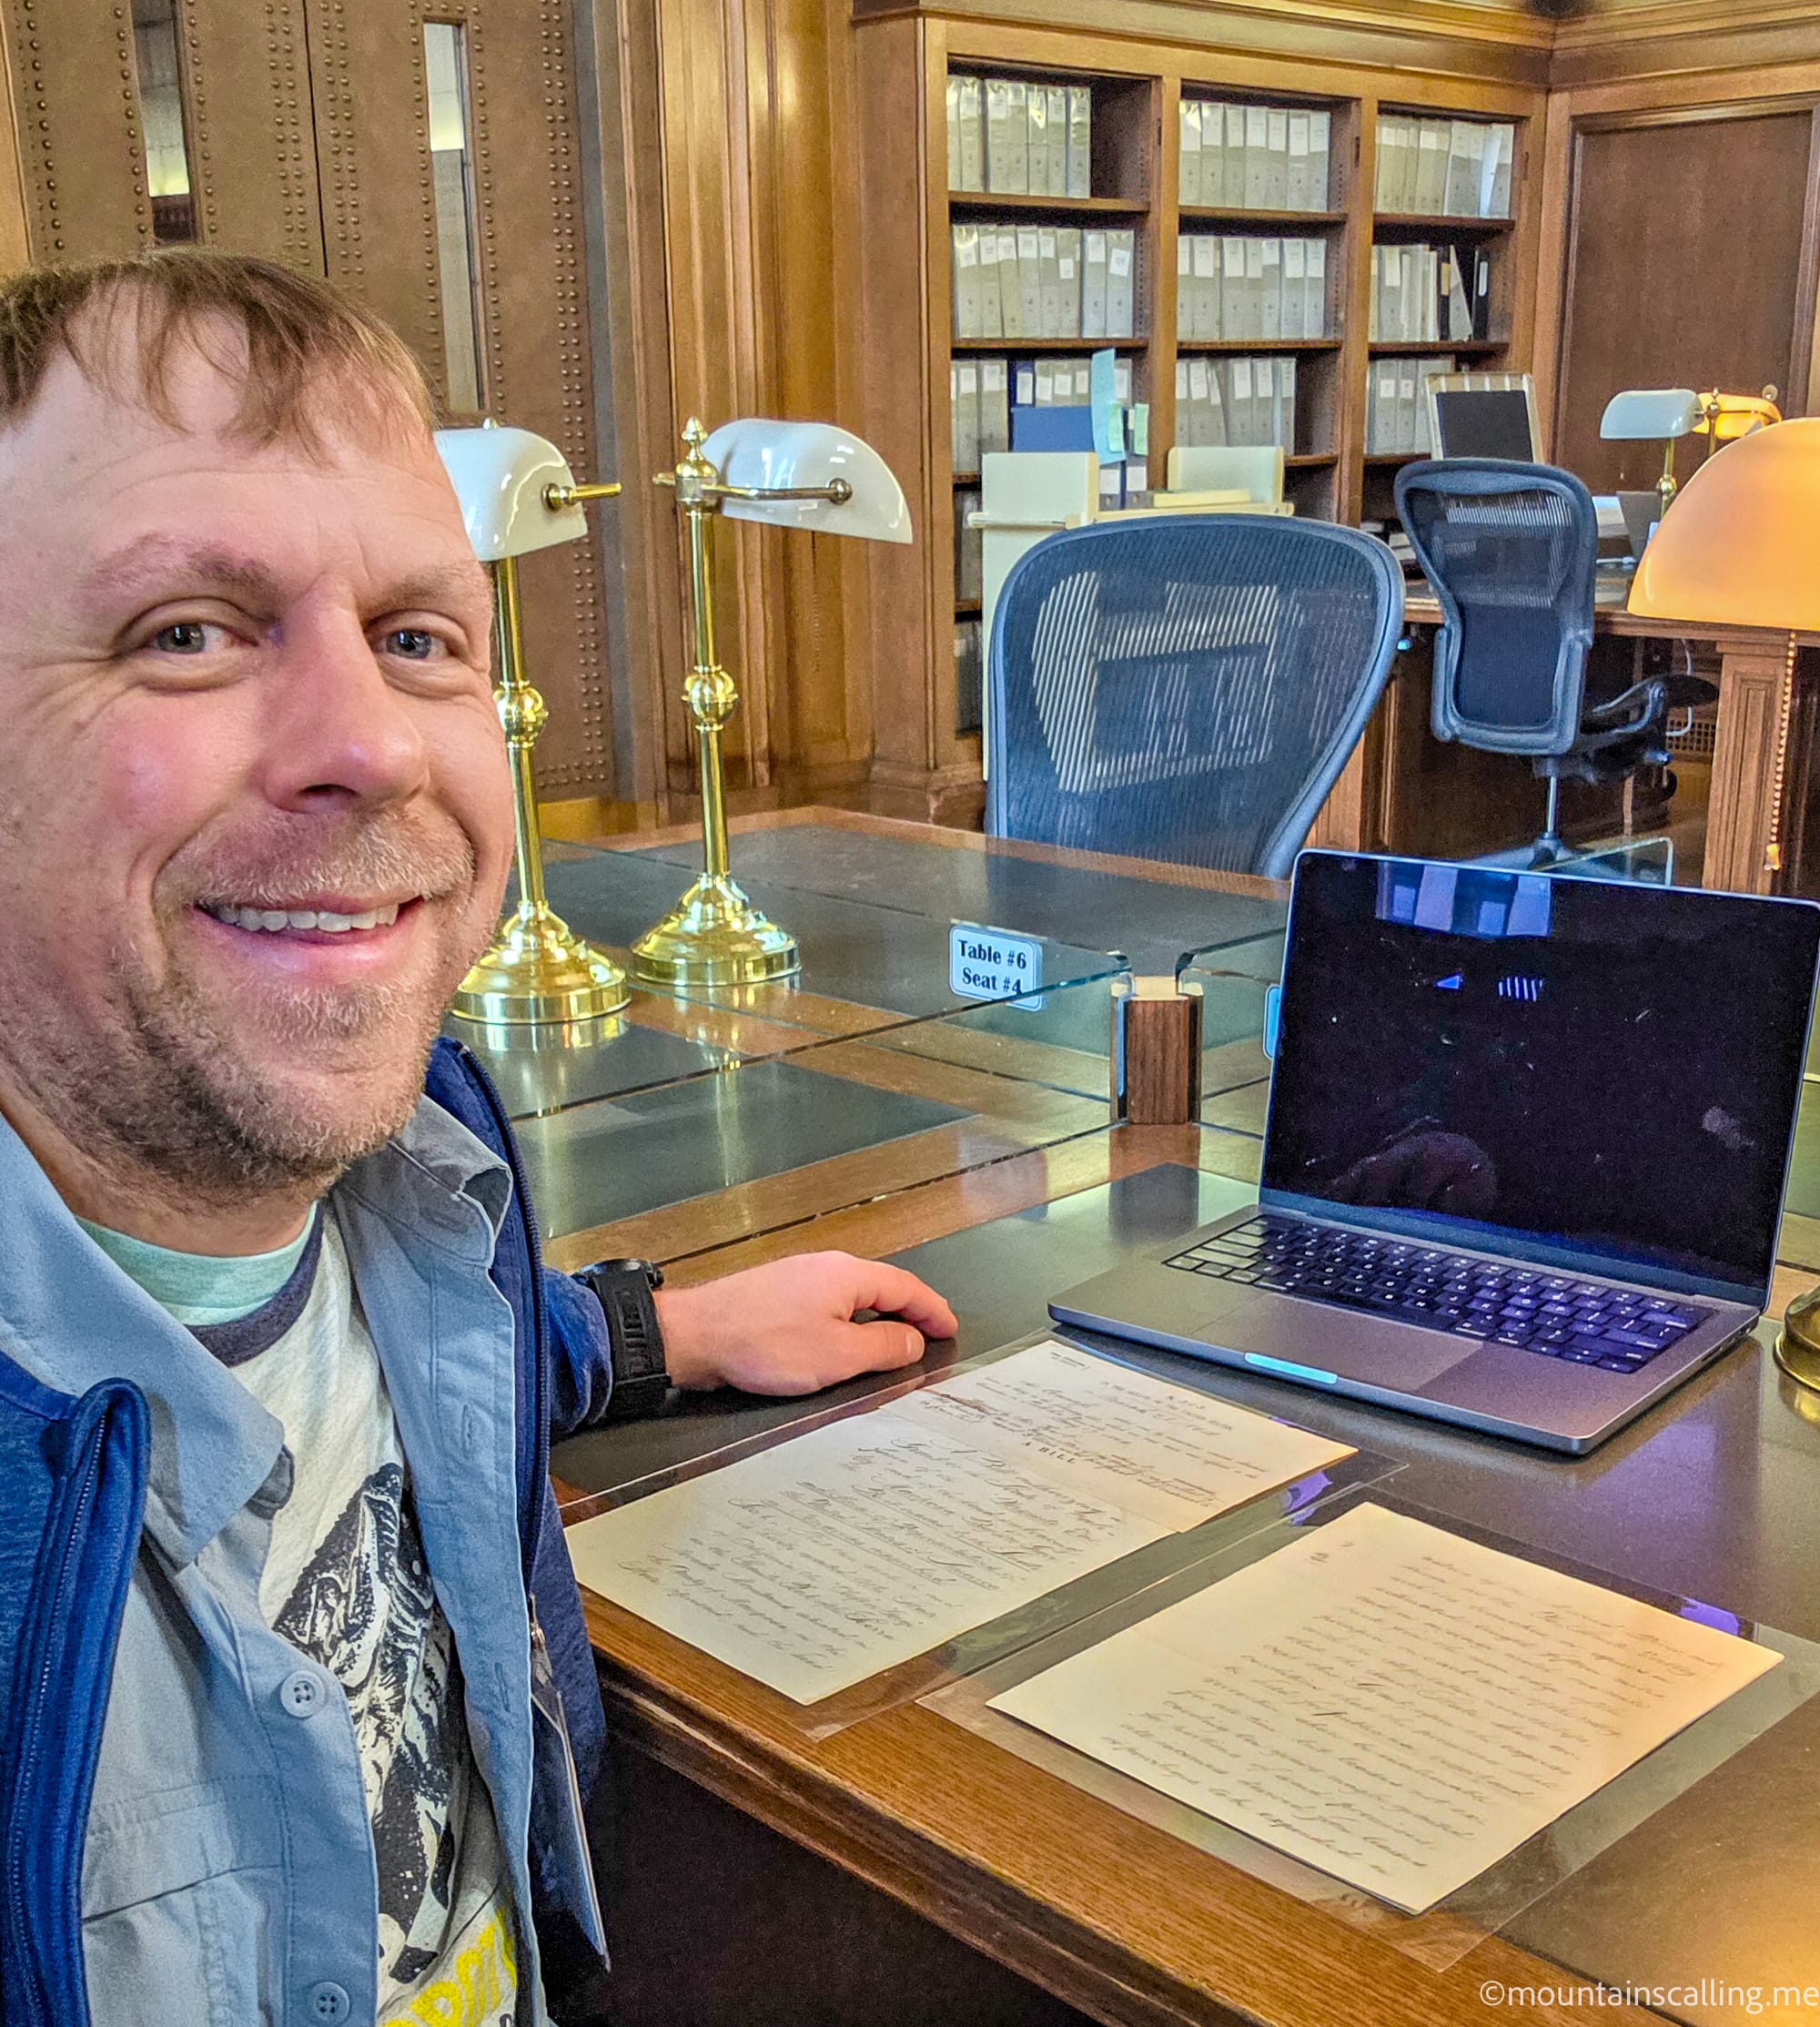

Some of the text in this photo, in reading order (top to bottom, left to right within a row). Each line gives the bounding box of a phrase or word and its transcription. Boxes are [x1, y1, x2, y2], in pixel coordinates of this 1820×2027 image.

[957, 938, 1027, 970] Table #6
[962, 967, 1023, 996] Seat #4
[1037, 1446, 1076, 1465] BILL
